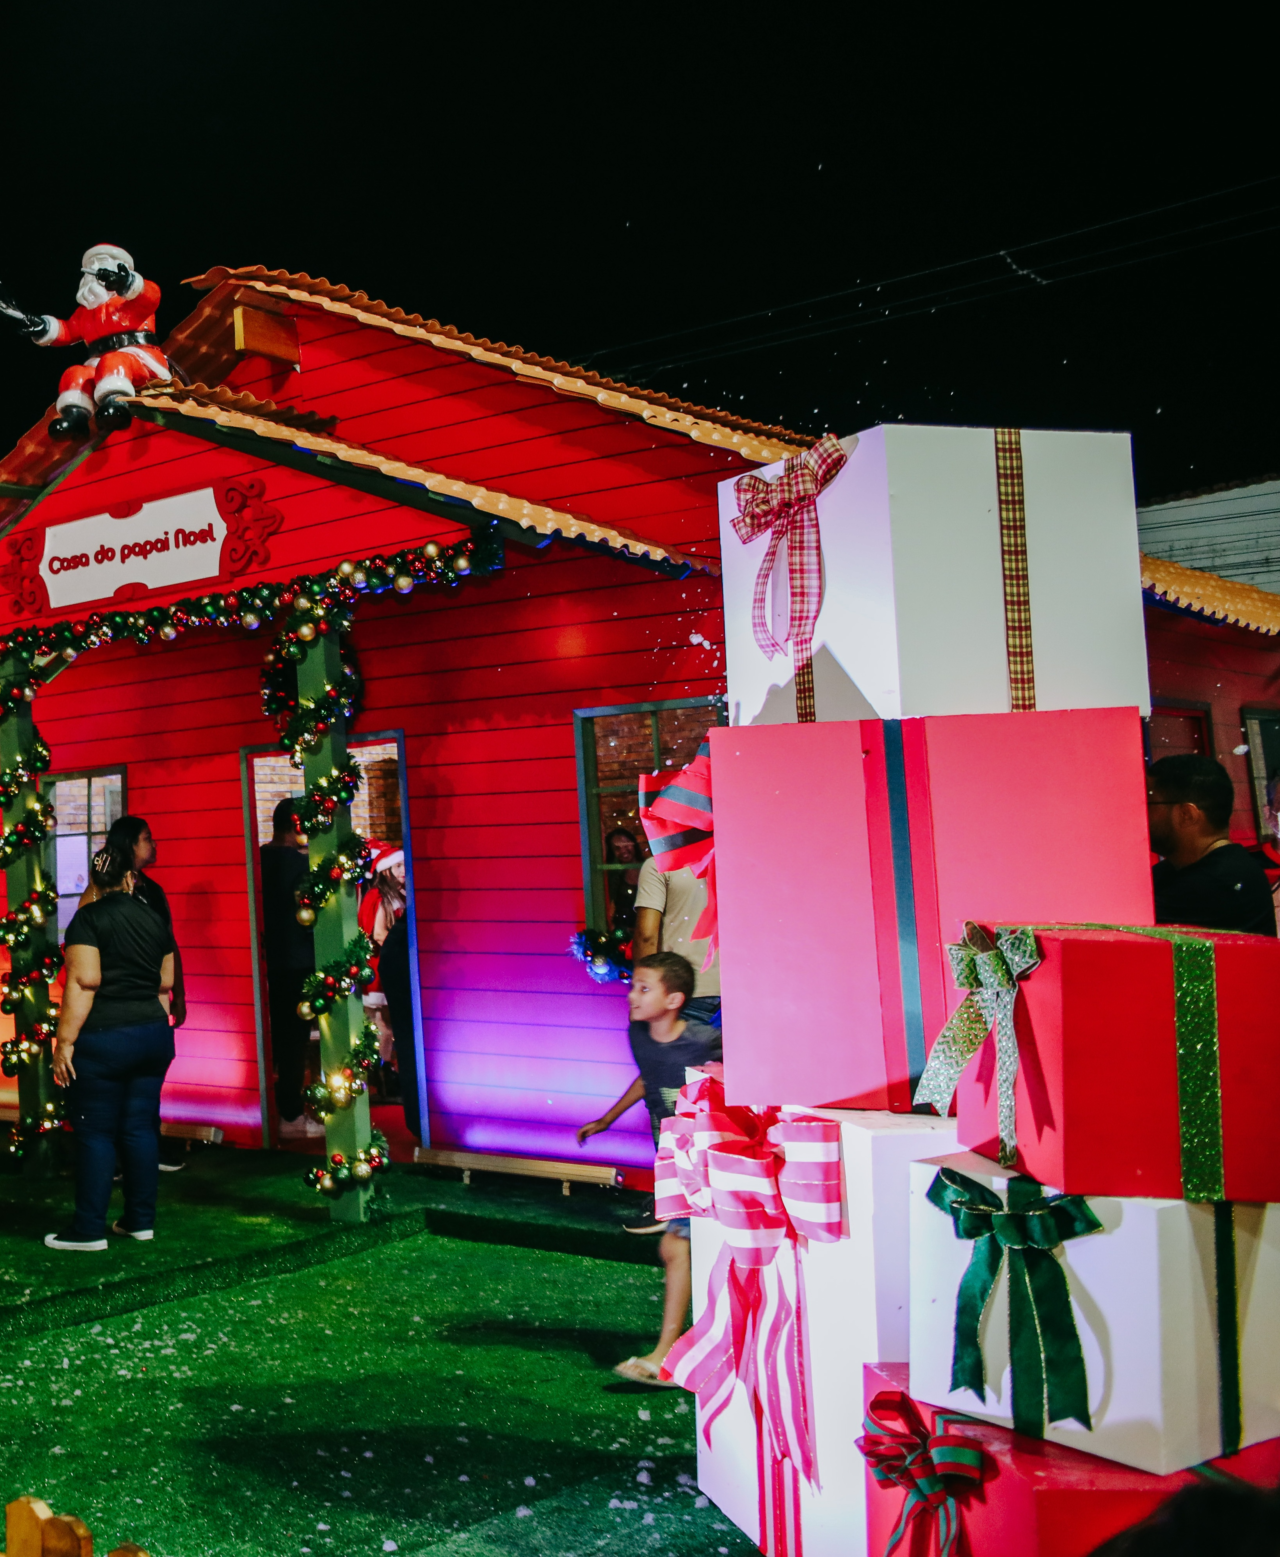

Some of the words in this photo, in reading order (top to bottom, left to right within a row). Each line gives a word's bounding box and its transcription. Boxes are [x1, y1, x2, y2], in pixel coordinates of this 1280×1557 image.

[48, 553, 90, 575] Casa
[94, 544, 116, 564] do
[120, 531, 170, 564] papai
[174, 522, 216, 549] Noel
